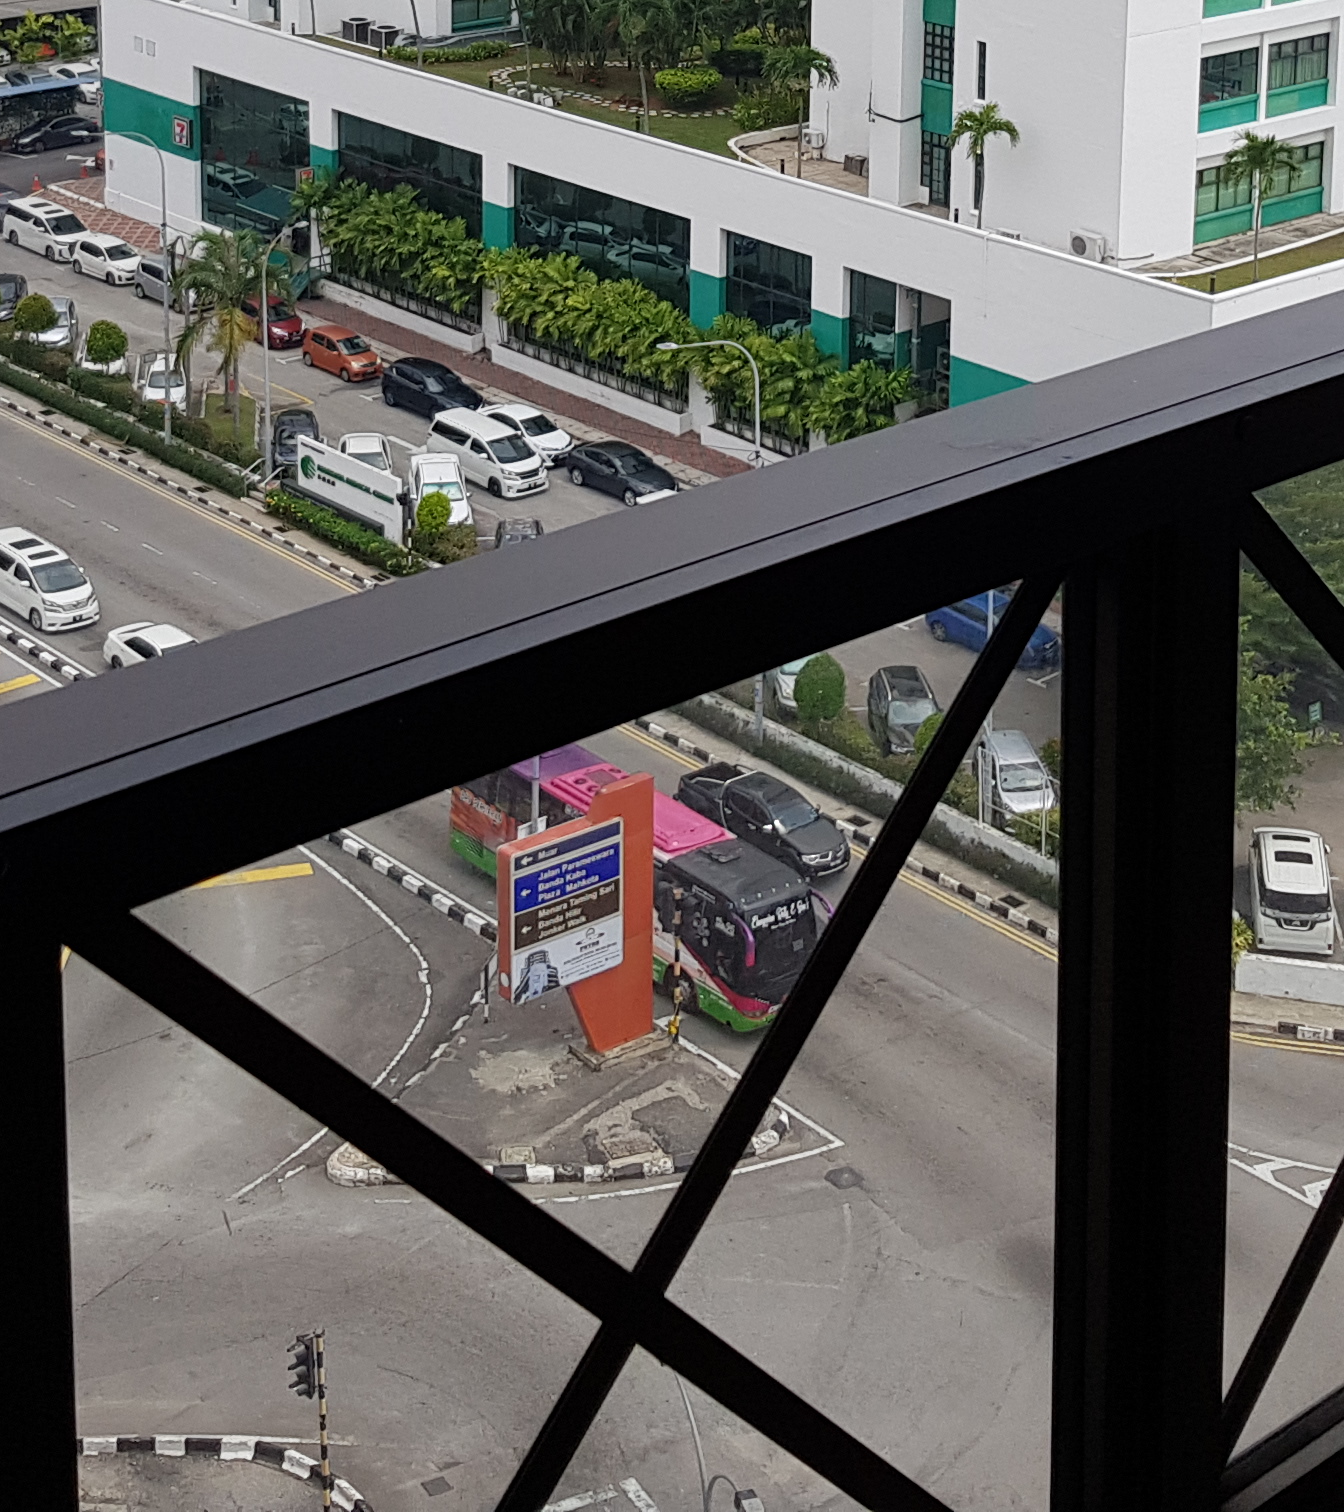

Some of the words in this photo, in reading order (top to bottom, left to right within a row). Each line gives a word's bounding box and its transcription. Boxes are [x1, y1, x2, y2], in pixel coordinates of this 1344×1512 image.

[538, 868, 560, 880] Jalan
[566, 870, 586, 881] Kaba
[538, 890, 561, 902] Plaza
[566, 875, 599, 891] Mahkota
[599, 883, 615, 894] Sari
[538, 925, 565, 938] Jonker
